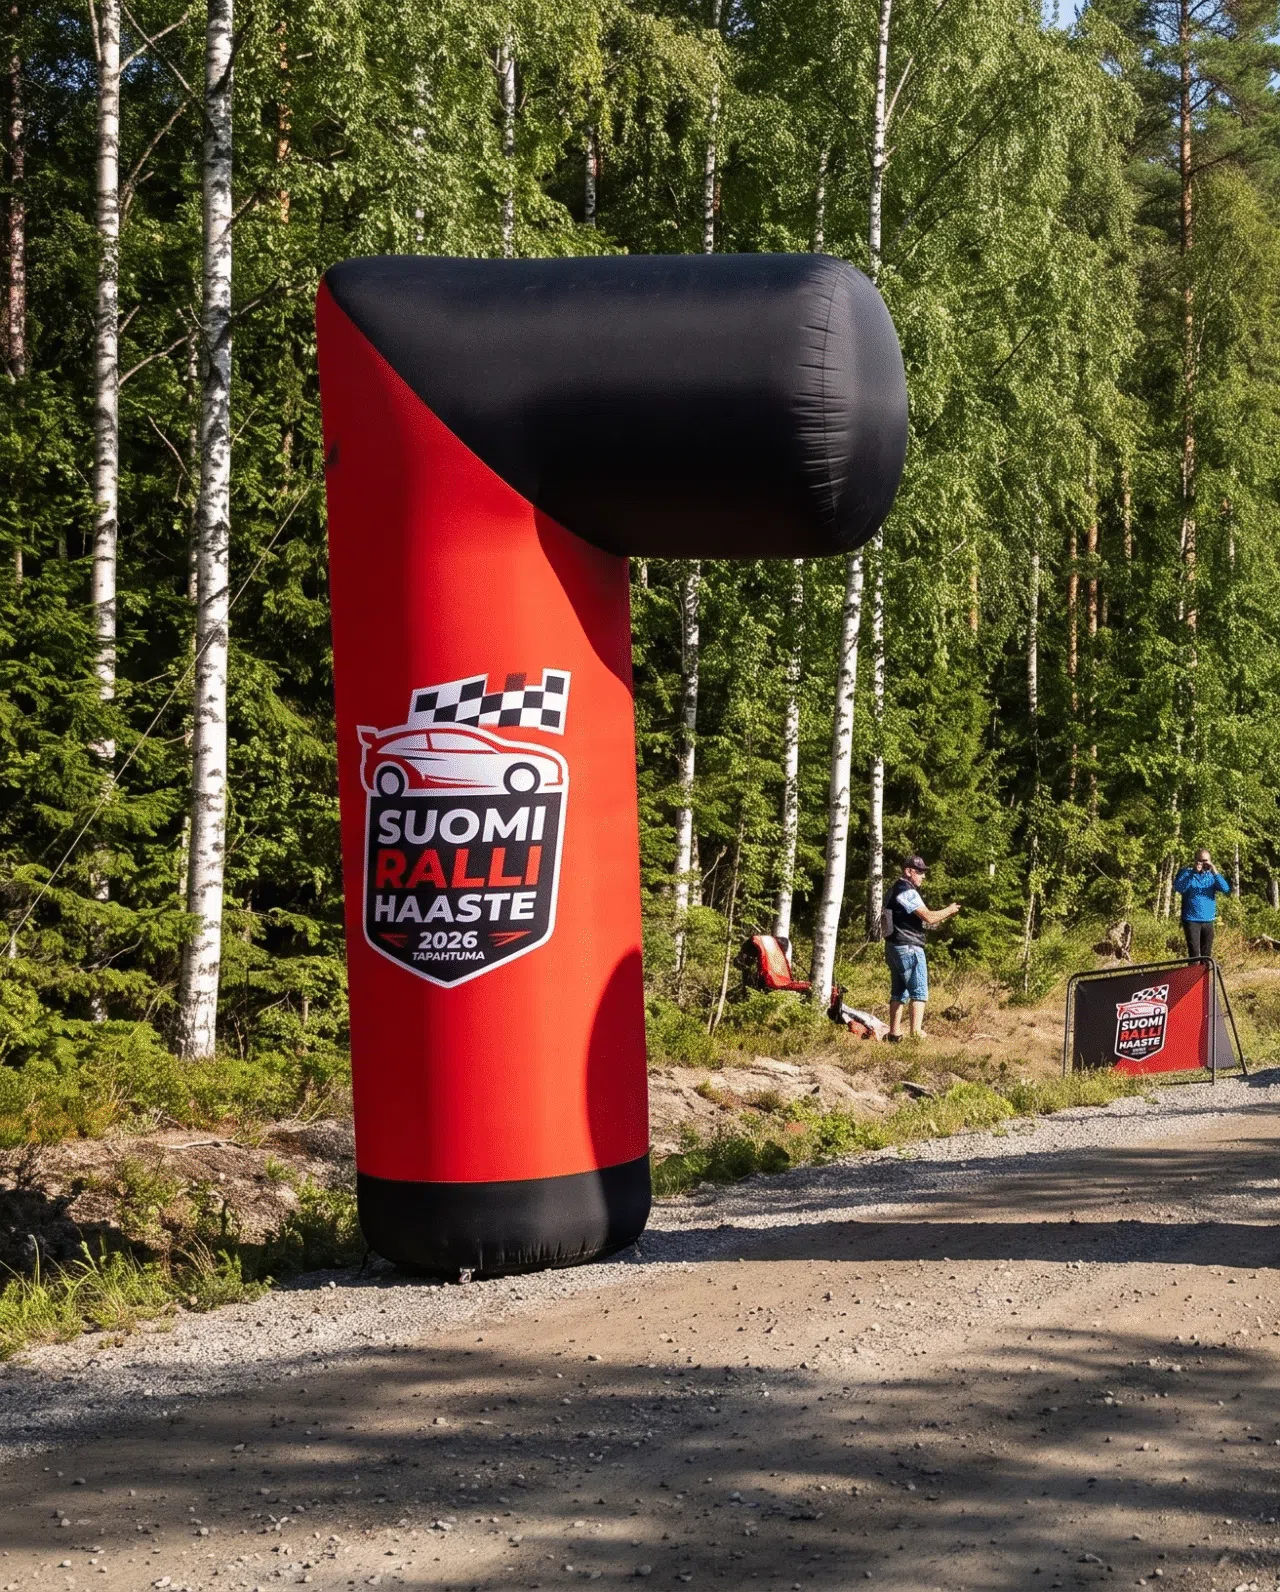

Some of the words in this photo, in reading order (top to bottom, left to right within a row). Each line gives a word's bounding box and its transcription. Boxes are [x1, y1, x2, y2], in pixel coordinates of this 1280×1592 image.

[377, 806, 547, 845] SUOMI
[375, 846, 543, 889] RALLI
[374, 891, 538, 923] HAASTE
[418, 931, 478, 950] 2026
[412, 949, 486, 961] TAPAHTUMA
[1121, 1015, 1163, 1031] SUOMI
[1120, 1026, 1162, 1041] RALLI
[1119, 1036, 1161, 1050] HAASTE
